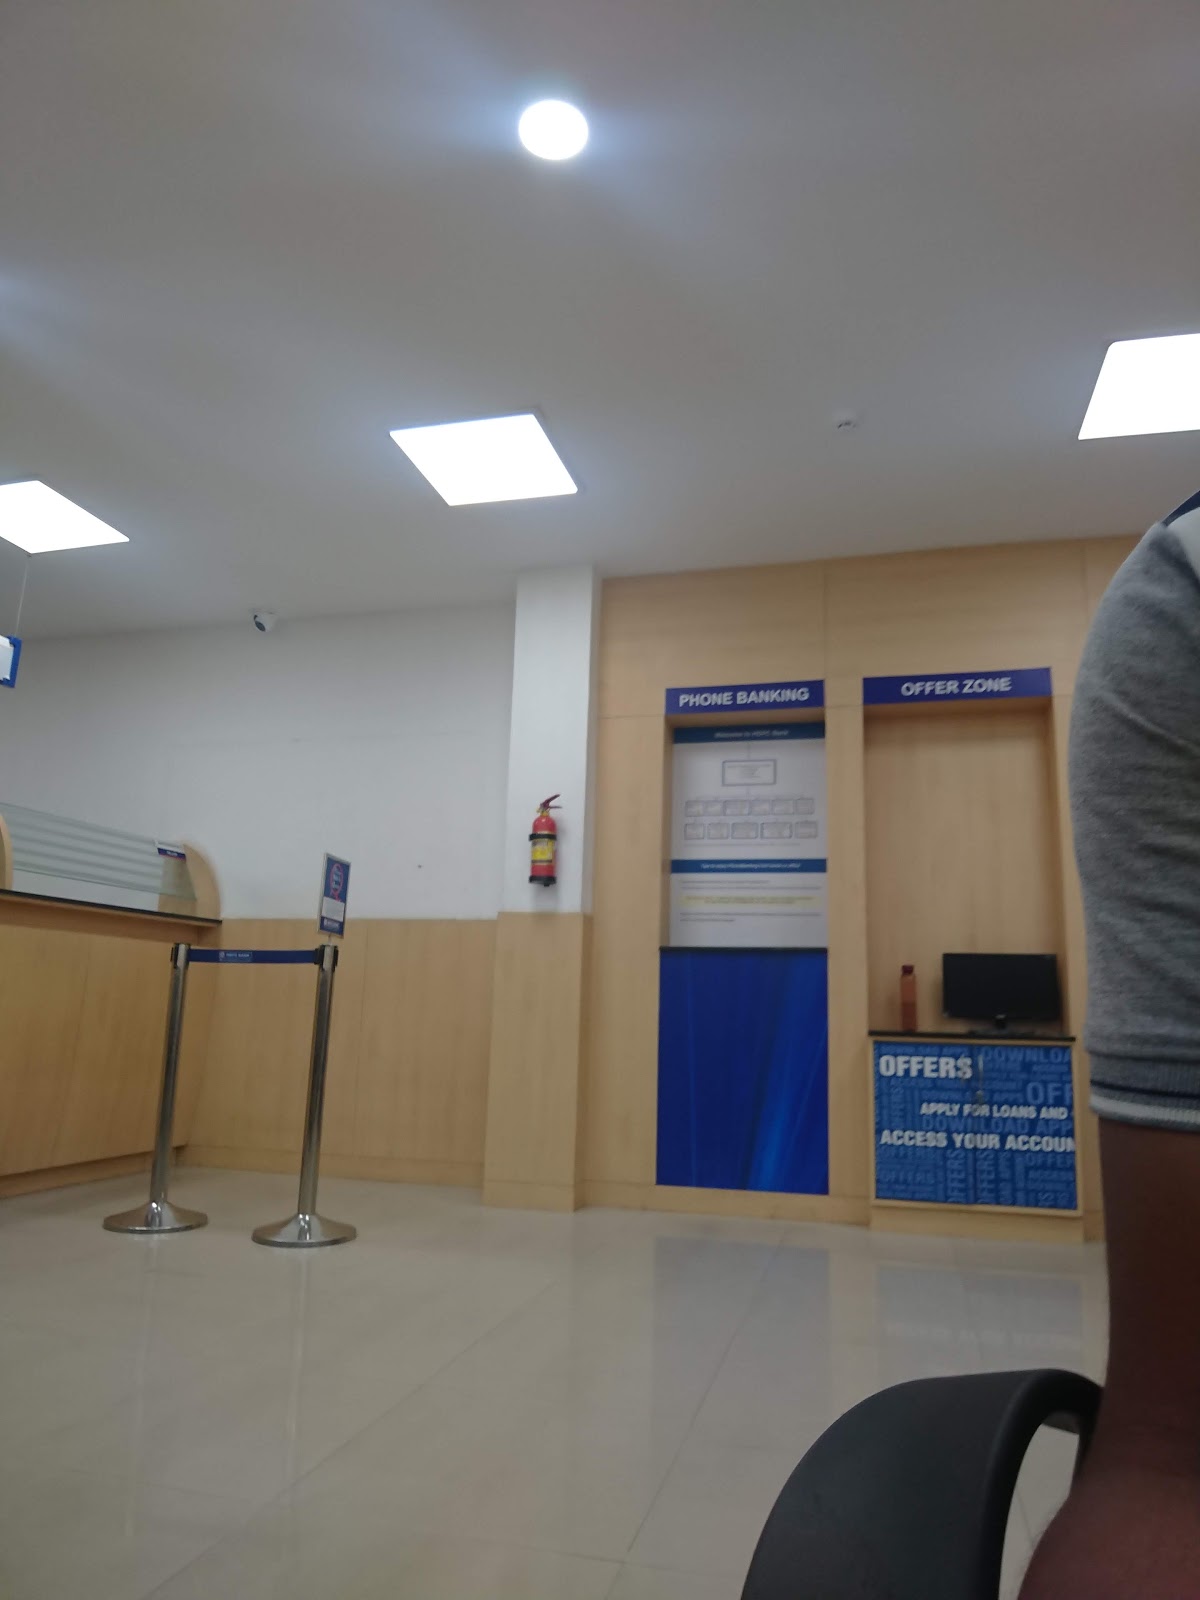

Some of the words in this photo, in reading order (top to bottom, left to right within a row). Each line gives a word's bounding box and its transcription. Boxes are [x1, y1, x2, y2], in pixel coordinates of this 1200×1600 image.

[901, 680, 960, 696] OFFER
[962, 677, 1012, 694] ZONE
[679, 691, 733, 707] PHONE
[736, 687, 810, 704] BANKING
[879, 1055, 973, 1079] OFFERS
[920, 1102, 960, 1116] APPLY
[963, 1103, 990, 1117] FOR
[992, 1104, 1037, 1119] LOANS
[1039, 1106, 1068, 1120] AND
[880, 1129, 948, 1148] ACCESS
[952, 1132, 1001, 1149] YOUR
